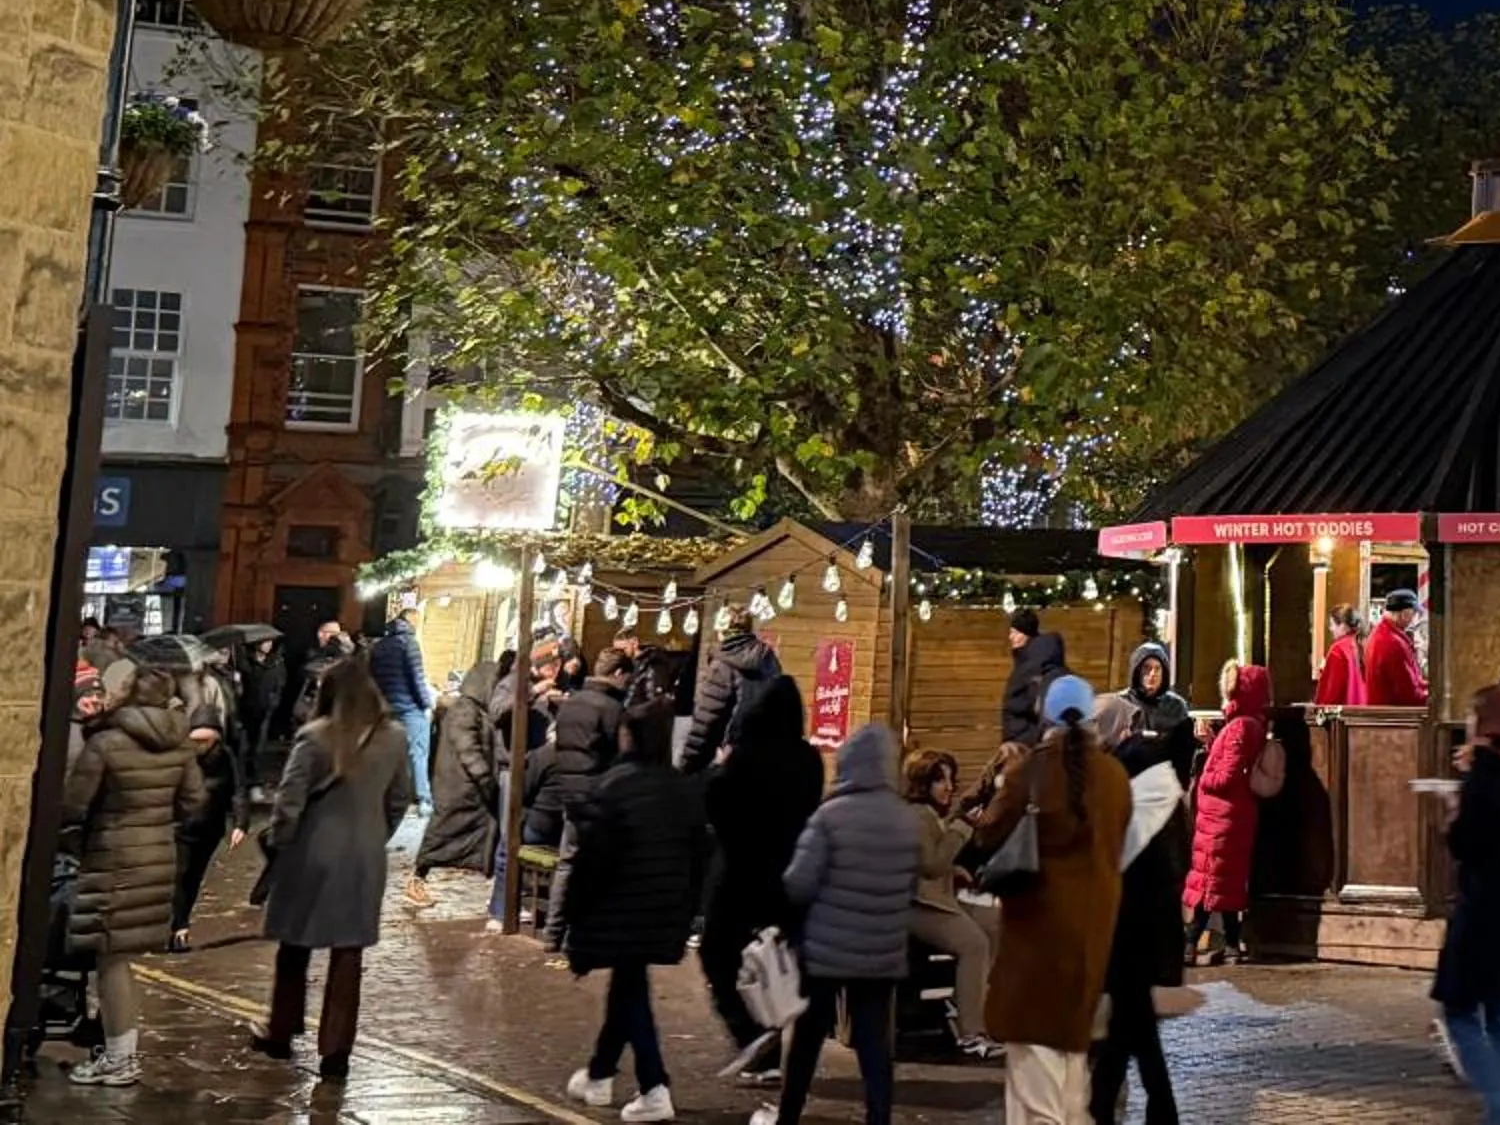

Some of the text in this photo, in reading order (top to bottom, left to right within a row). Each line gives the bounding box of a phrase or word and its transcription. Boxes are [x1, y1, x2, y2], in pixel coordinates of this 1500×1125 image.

[1213, 521, 1375, 537] WINTER HOT TODDIES
[1457, 522, 1486, 534] HOT
